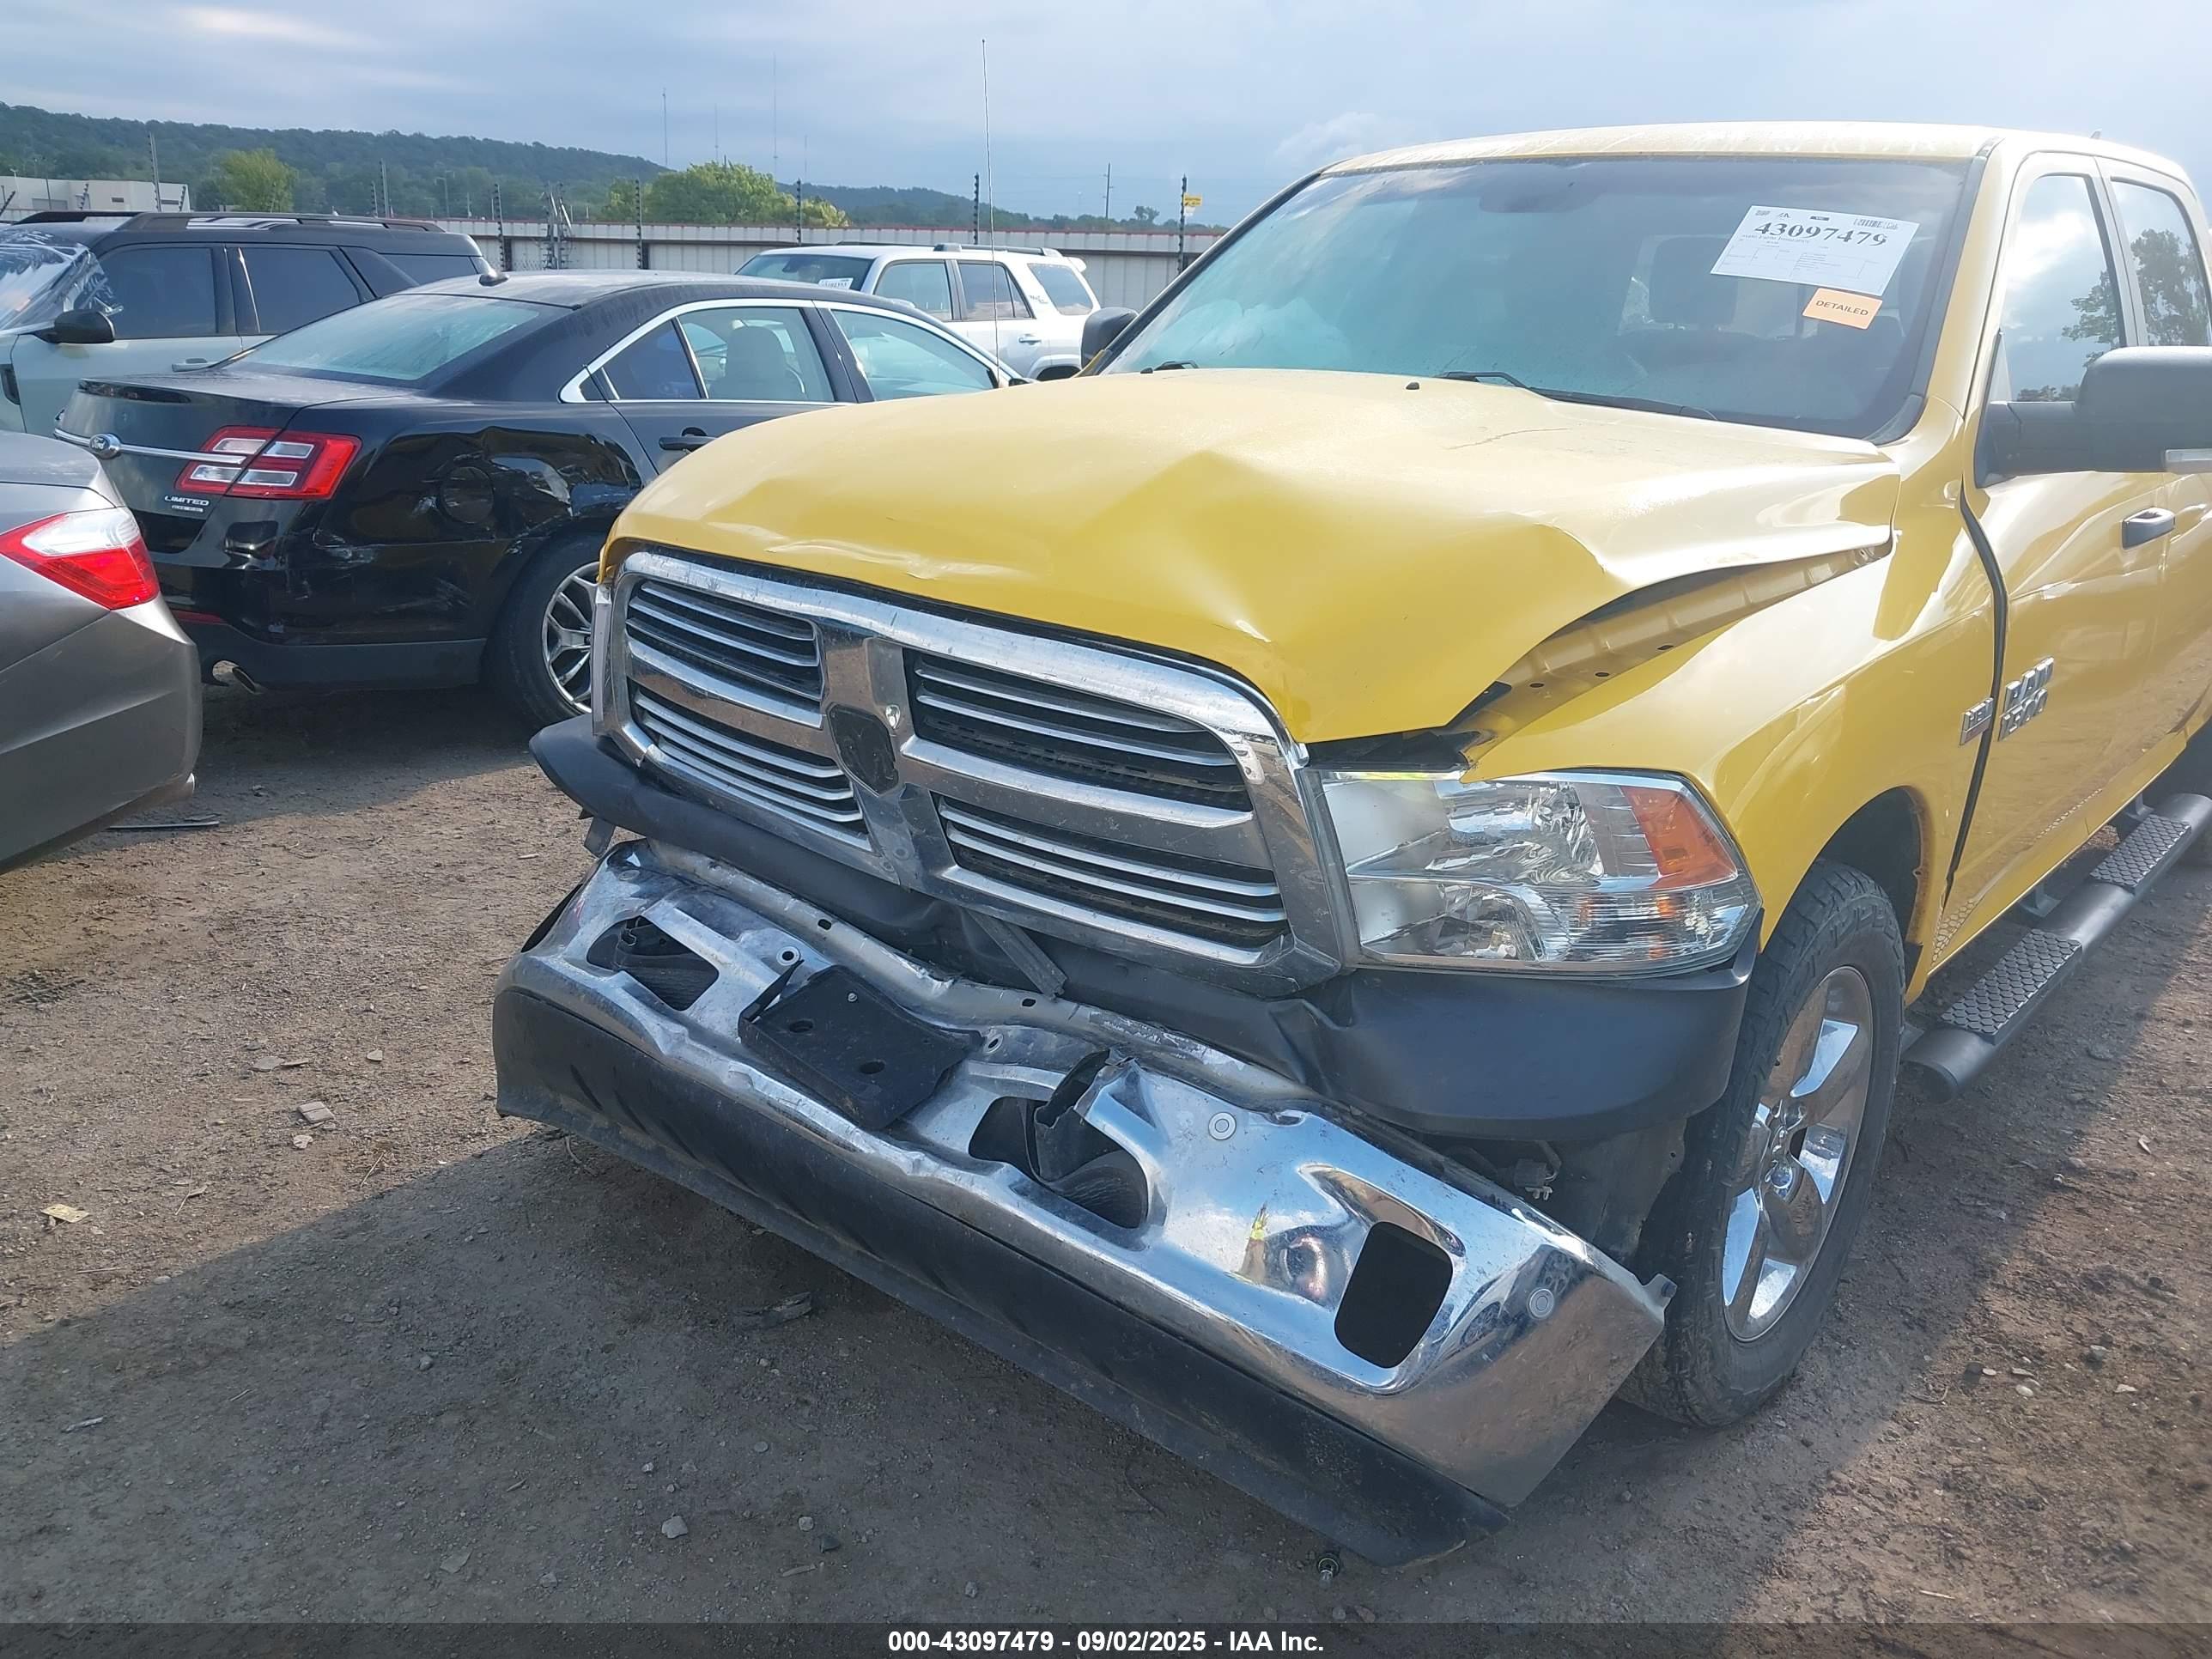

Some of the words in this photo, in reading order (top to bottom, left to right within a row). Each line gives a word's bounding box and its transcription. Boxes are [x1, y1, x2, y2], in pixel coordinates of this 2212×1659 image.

[1754, 222, 1888, 246] 43097479
[1815, 300, 1869, 316] DETAILED
[164, 495, 210, 506] LIMITED
